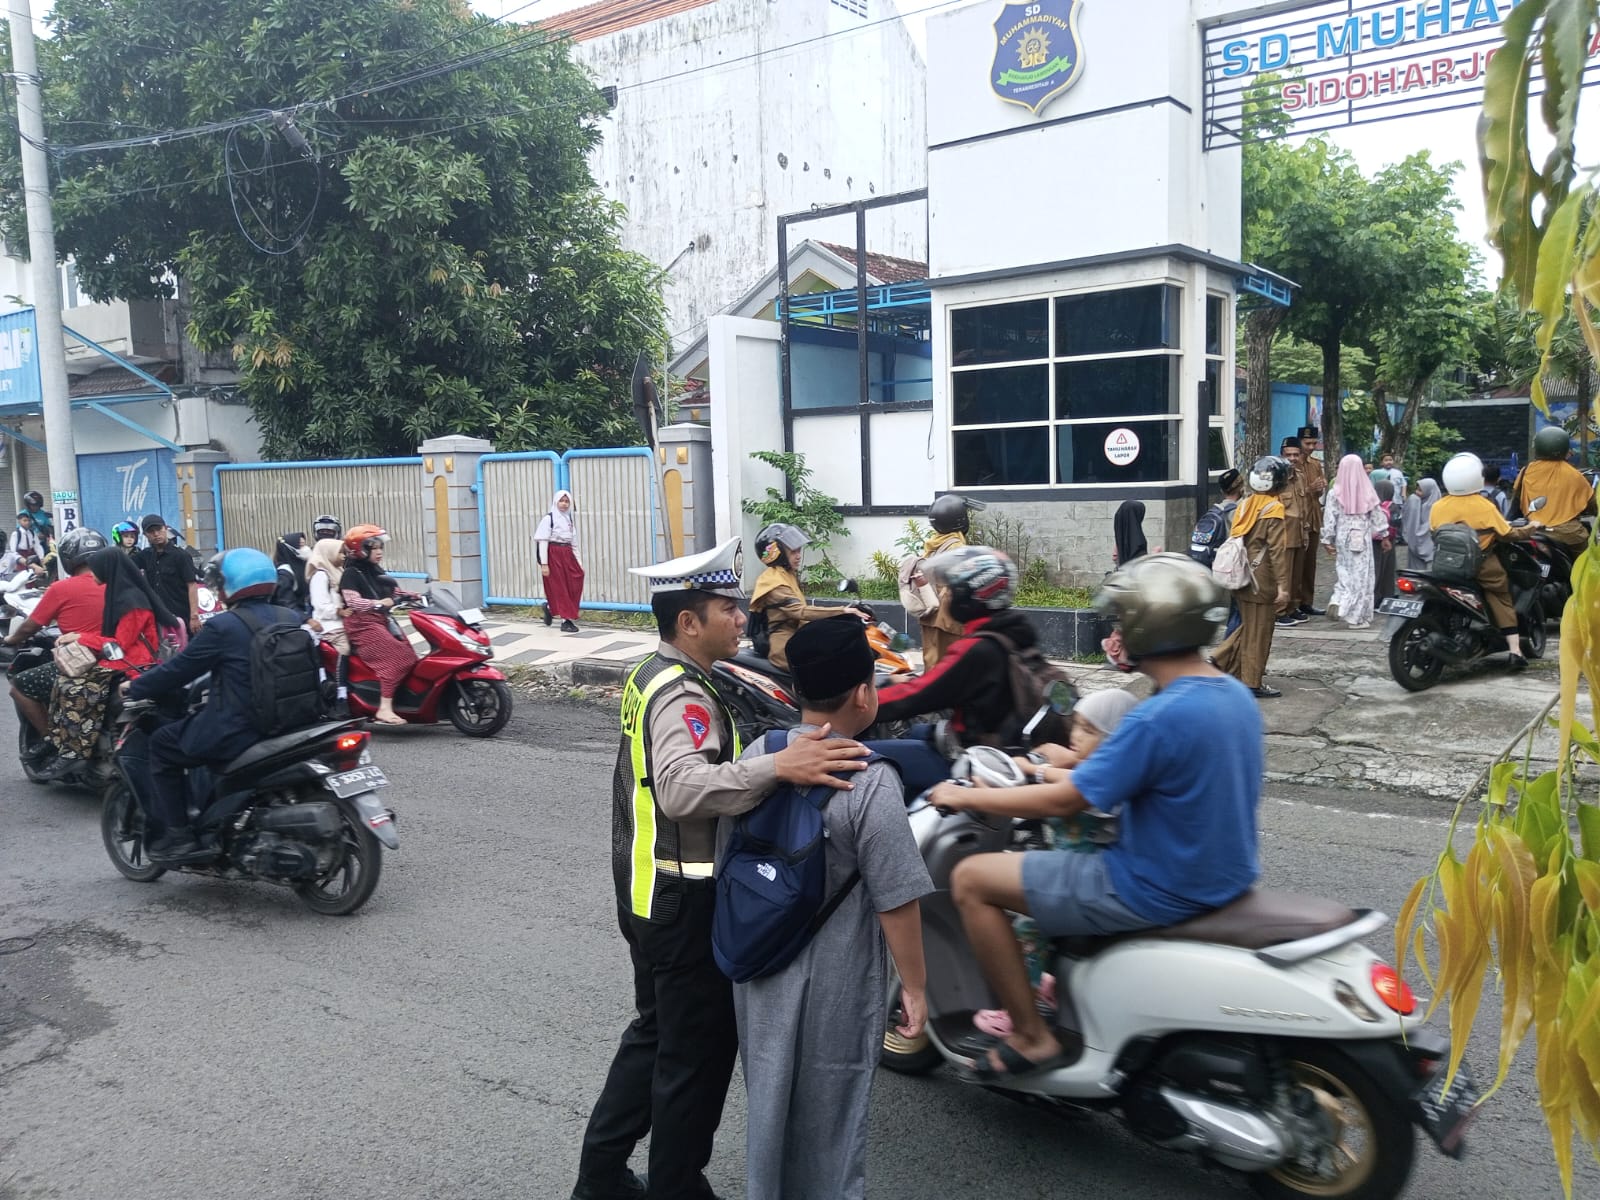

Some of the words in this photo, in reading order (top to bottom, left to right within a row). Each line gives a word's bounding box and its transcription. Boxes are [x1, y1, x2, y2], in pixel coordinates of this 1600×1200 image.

[1025, 4, 1040, 16] SD
[1000, 15, 1068, 46] MUHAMMADIYAH
[1222, 33, 1290, 77] SD
[1317, 0, 1521, 59] MUHA
